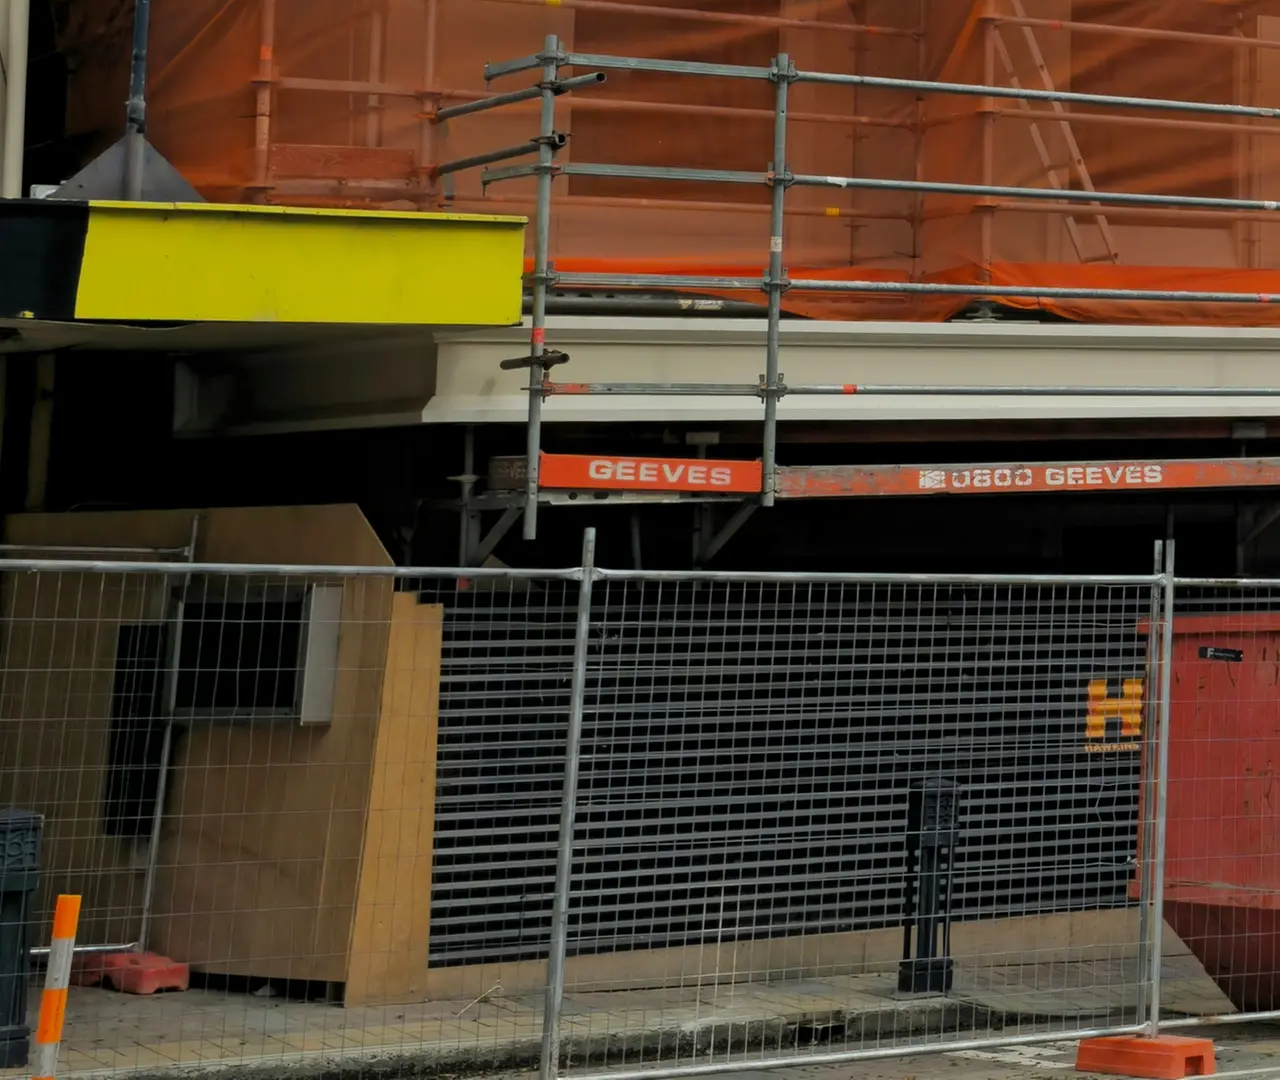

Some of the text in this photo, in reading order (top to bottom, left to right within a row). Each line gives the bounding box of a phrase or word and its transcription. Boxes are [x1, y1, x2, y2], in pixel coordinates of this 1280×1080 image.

[588, 459, 732, 485] GEEVES
[951, 465, 1163, 488] 0800 GEEVES
[1085, 678, 1144, 738] H
